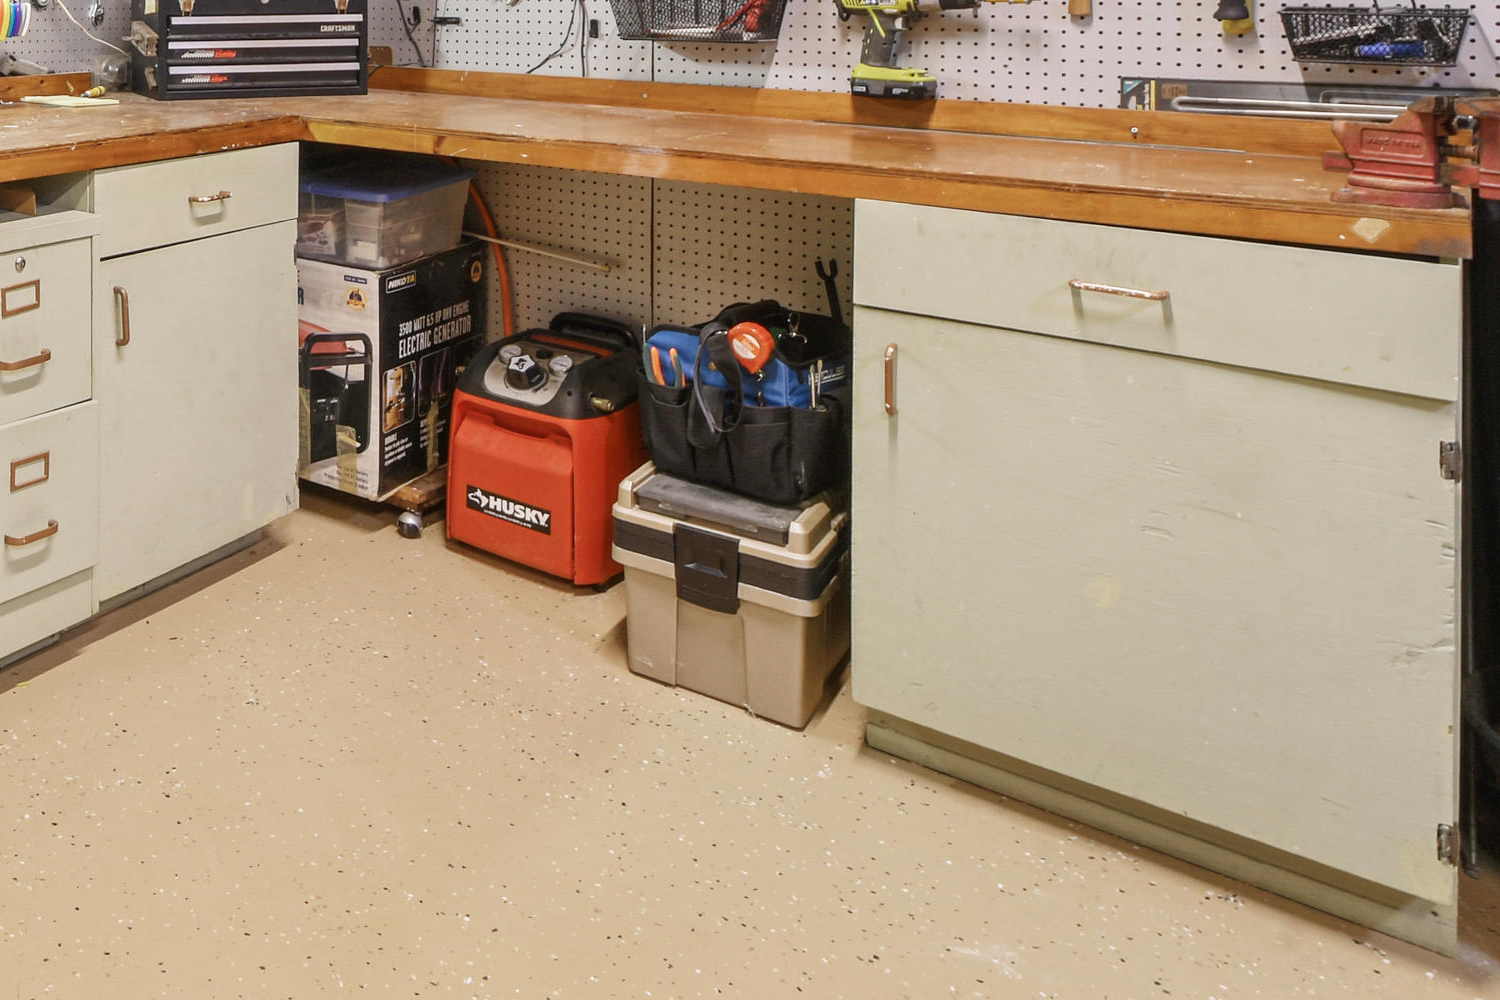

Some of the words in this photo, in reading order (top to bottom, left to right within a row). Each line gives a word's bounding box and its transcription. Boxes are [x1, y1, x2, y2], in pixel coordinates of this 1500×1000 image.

[320, 24, 356, 32] CRAFTSMAN
[387, 274, 416, 290] NIKOTA
[399, 320, 412, 337] 3500
[413, 315, 426, 332] WATT
[399, 330, 432, 360] ELECTRIC
[433, 314, 472, 345] GENERATOR
[488, 495, 550, 527] HUSKY
